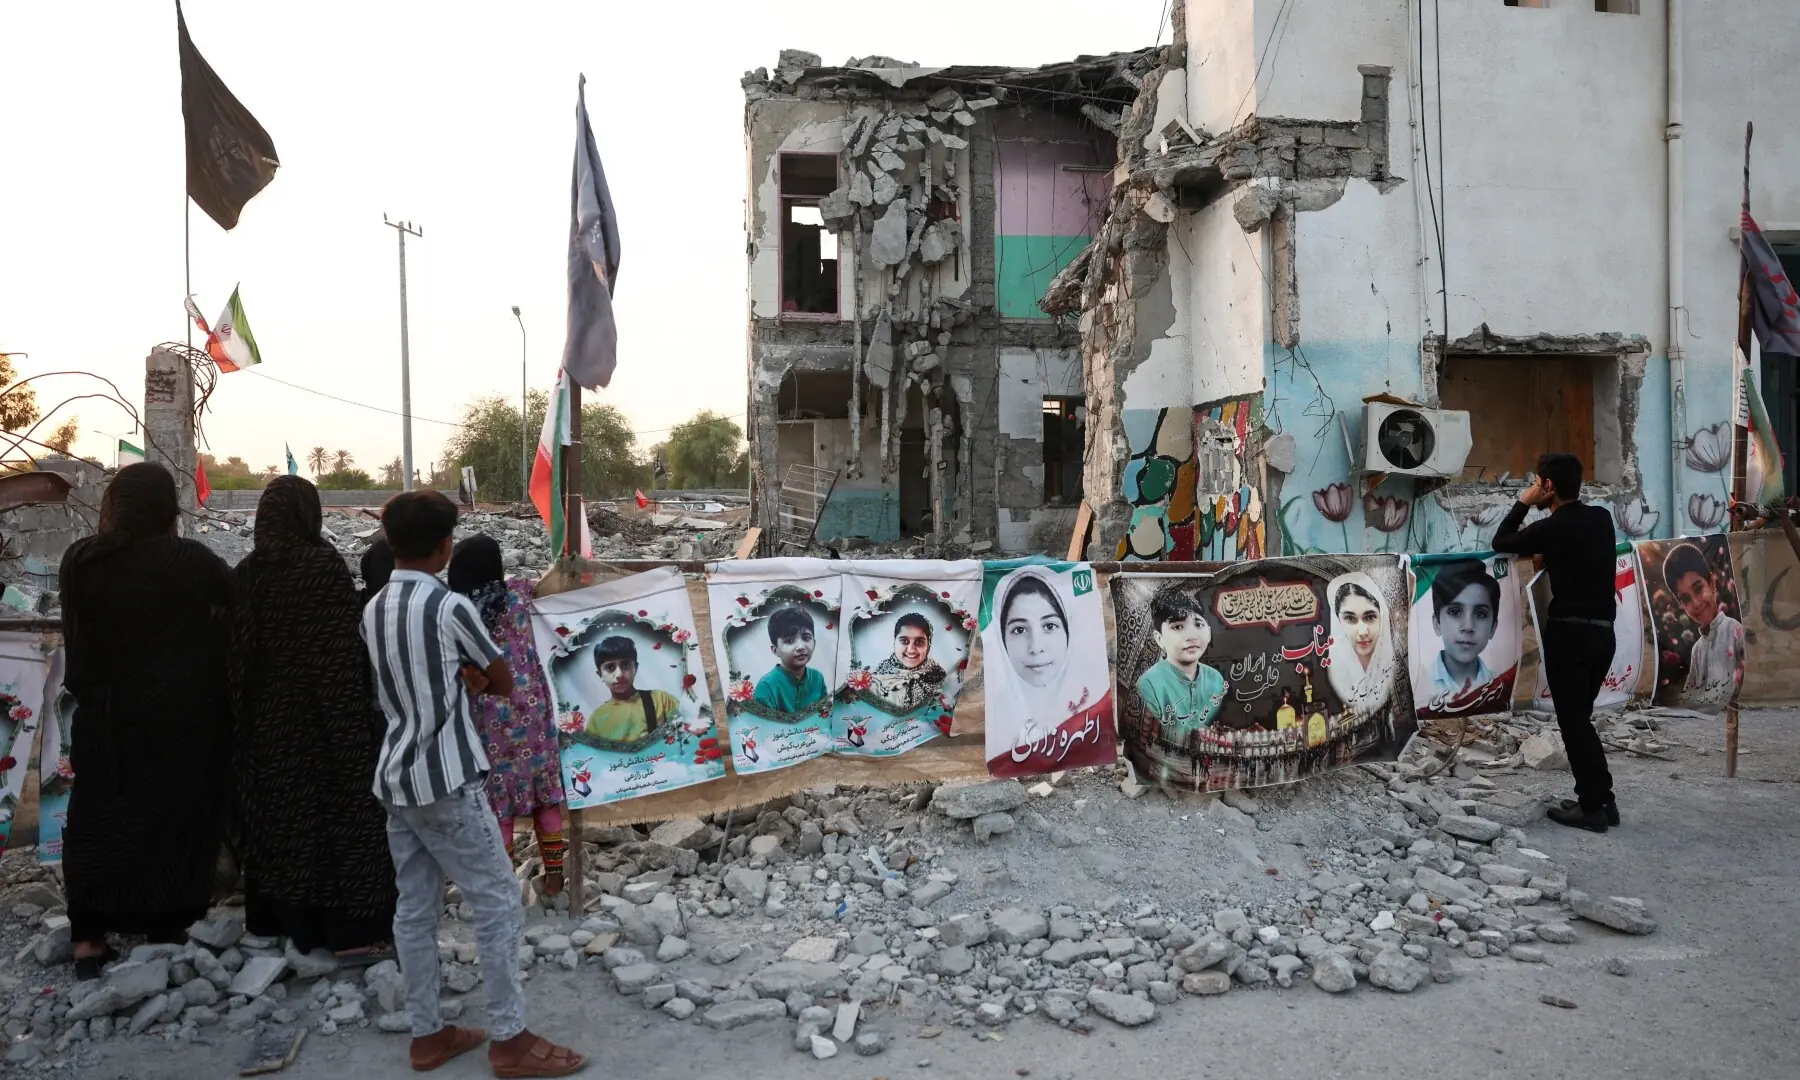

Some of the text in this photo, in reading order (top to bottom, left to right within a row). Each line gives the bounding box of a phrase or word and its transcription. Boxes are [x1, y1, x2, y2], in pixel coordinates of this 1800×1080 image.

[1282, 625, 1334, 673] میناب
[772, 724, 819, 741] شهید دانش آموز
[1057, 711, 1100, 762] اطهره
[776, 743, 794, 753] کیش
[805, 738, 817, 748] علی
[609, 752, 666, 772] شهید دانش آموز
[624, 769, 655, 783] علی زارعی
